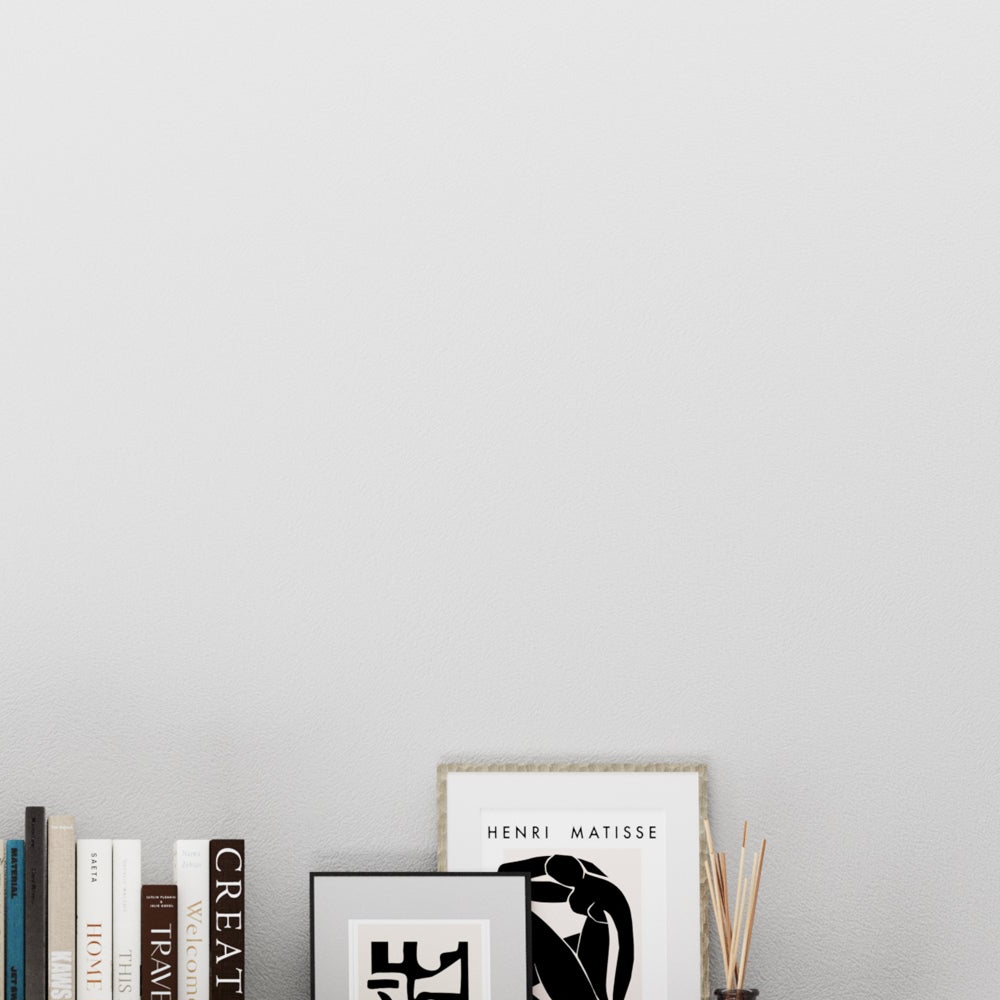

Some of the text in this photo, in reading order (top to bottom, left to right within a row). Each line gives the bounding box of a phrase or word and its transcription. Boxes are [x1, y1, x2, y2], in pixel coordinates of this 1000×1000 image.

[487, 825, 657, 840] HENRI MATISSE
[10, 847, 18, 900] MATERIAL
[90, 852, 98, 883] SAETA
[10, 966, 18, 985] JET
[50, 950, 73, 1000] KAWS
[86, 923, 102, 992] HOME
[117, 949, 132, 993] THIS
